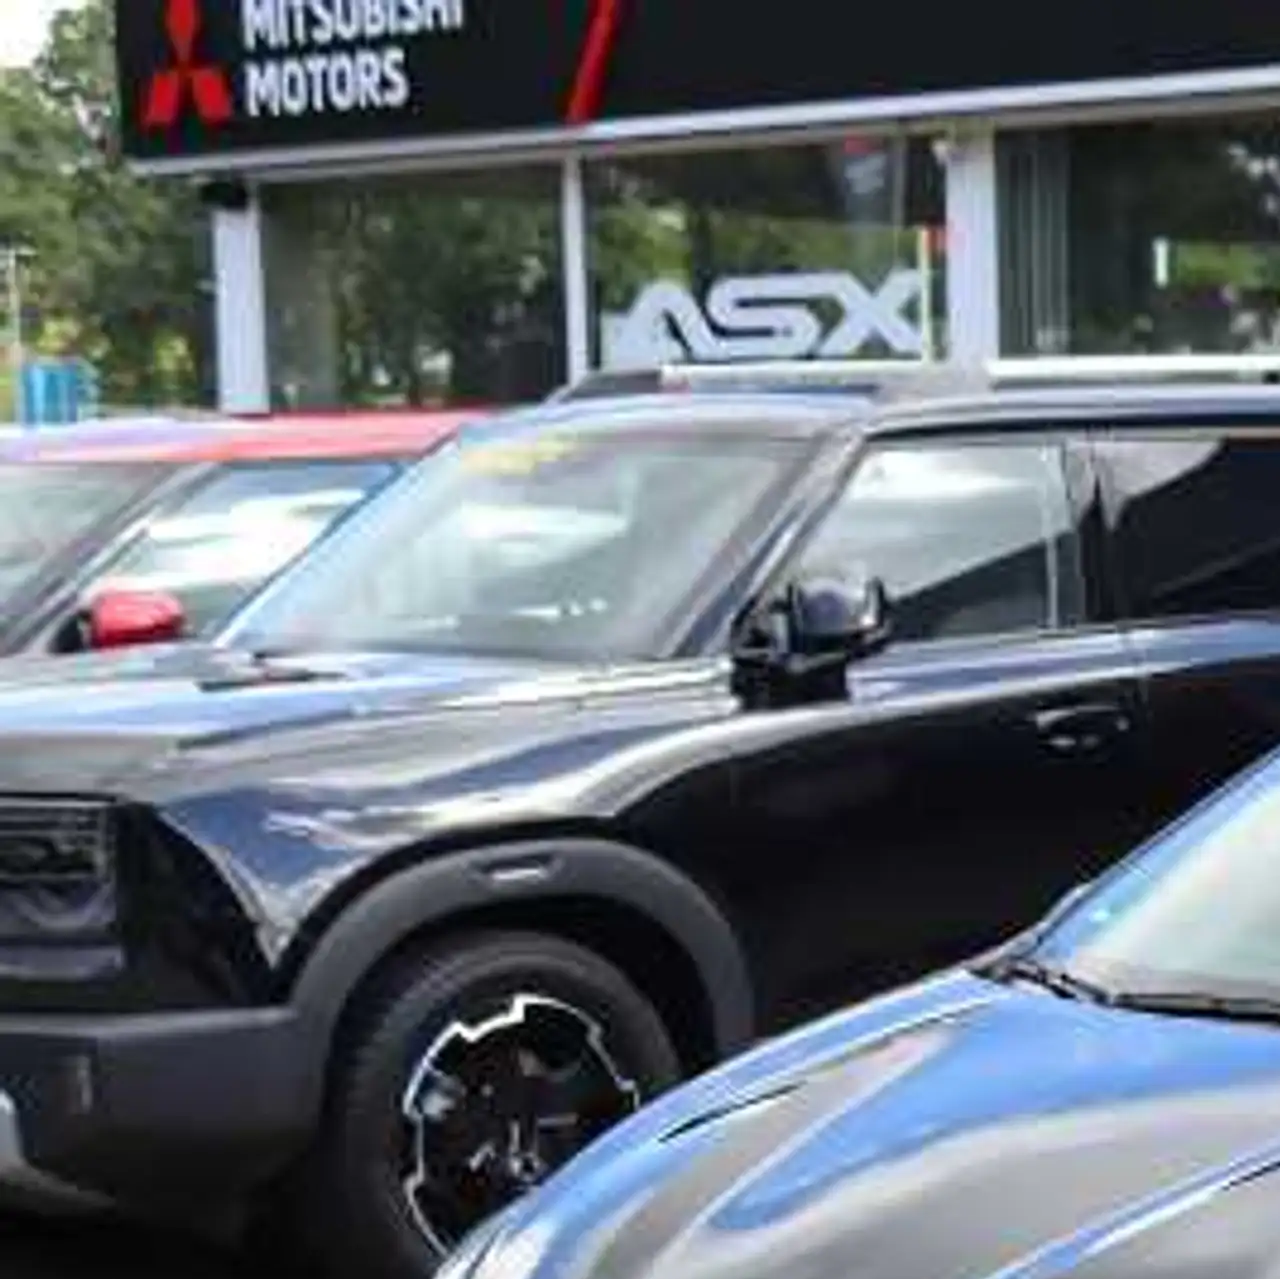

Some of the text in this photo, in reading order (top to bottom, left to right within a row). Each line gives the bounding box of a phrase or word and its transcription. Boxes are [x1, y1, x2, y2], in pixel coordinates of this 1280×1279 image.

[242, 0, 463, 49] MITSUBISHI
[245, 47, 408, 117] MOTORS
[606, 269, 926, 366] ASX
